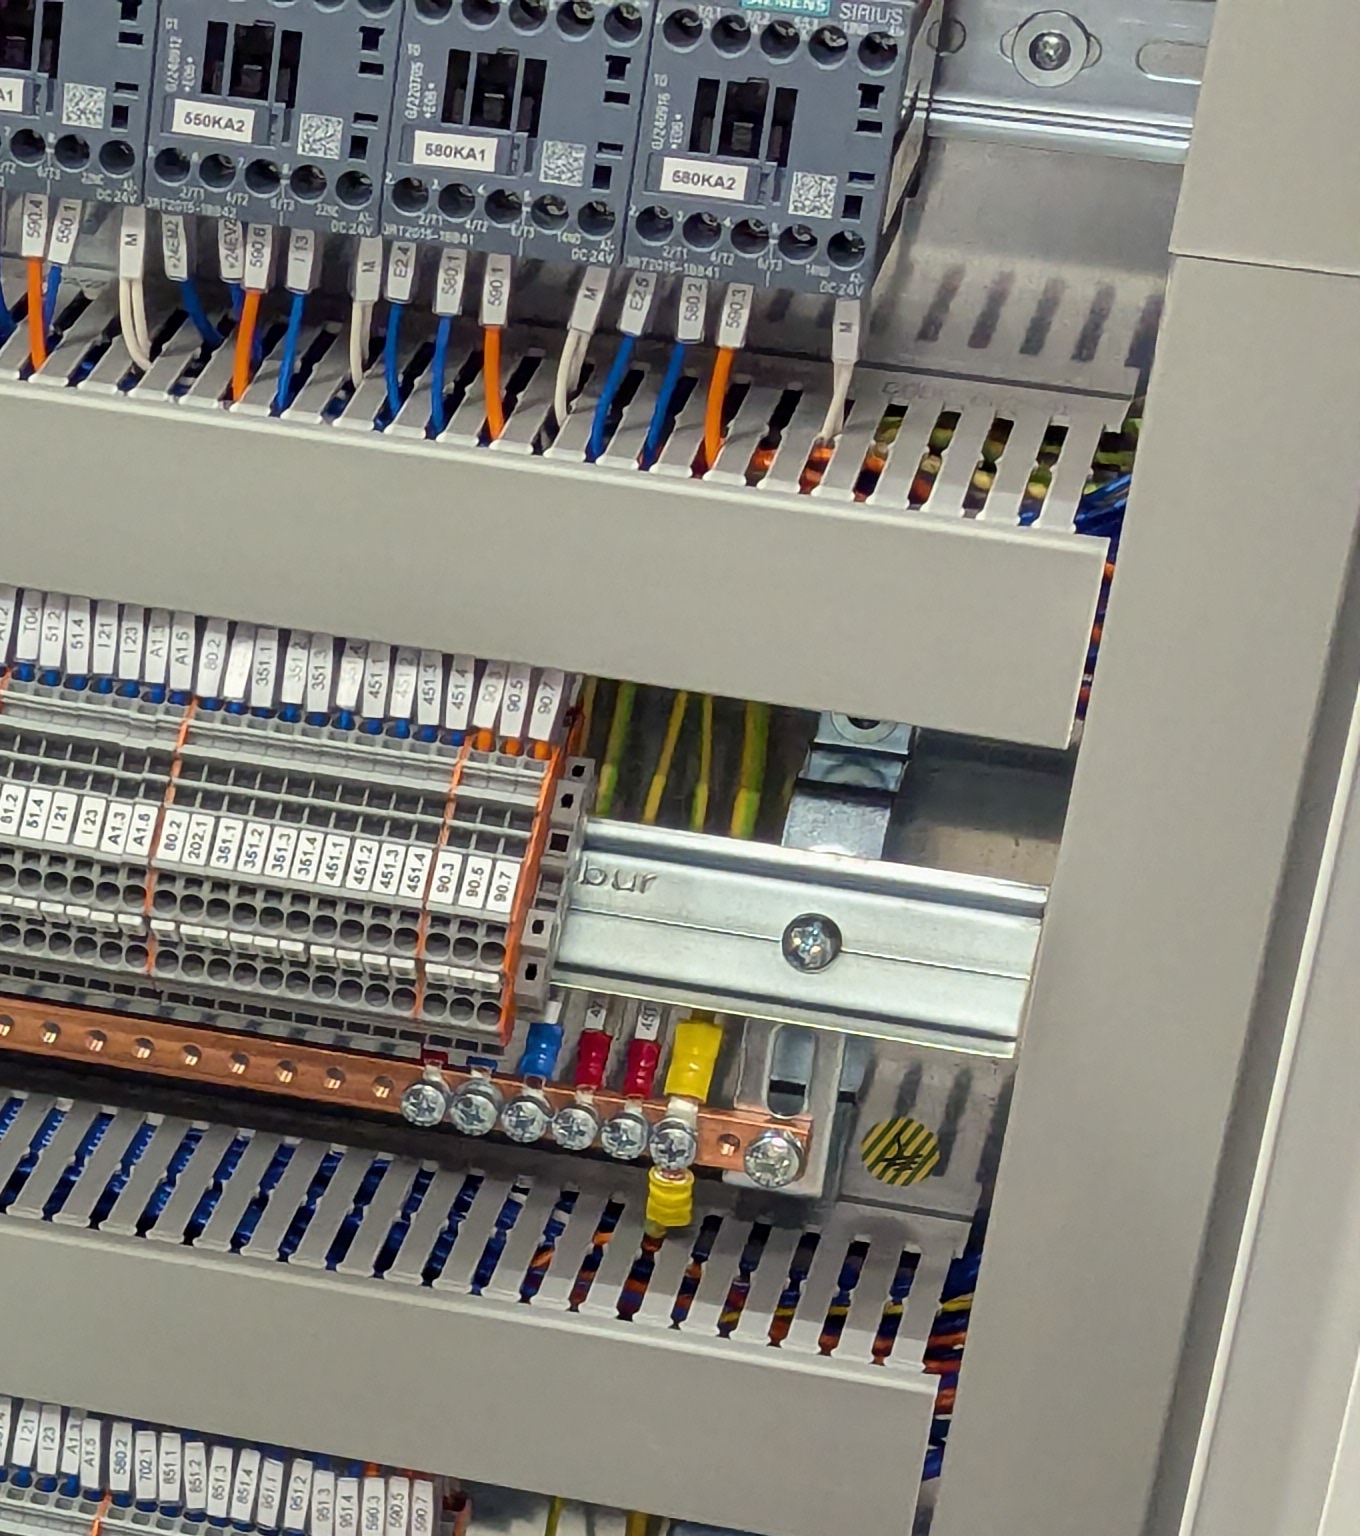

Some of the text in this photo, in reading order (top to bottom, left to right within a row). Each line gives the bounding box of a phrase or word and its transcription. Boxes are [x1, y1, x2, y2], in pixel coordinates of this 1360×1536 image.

[839, 3, 904, 24] SIRIUS
[425, 143, 486, 162] 580KA1
[538, 681, 556, 715] 90.7
[108, 811, 126, 844] A1.3
[188, 821, 208, 859] 202.1
[244, 828, 264, 868] 351.2
[354, 845, 373, 884] 451.2
[380, 849, 399, 889] 451.3
[406, 853, 426, 893] 451.4
[436, 863, 455, 893] 90.3
[466, 867, 484, 897] 90.5
[494, 872, 512, 902] 90.7
